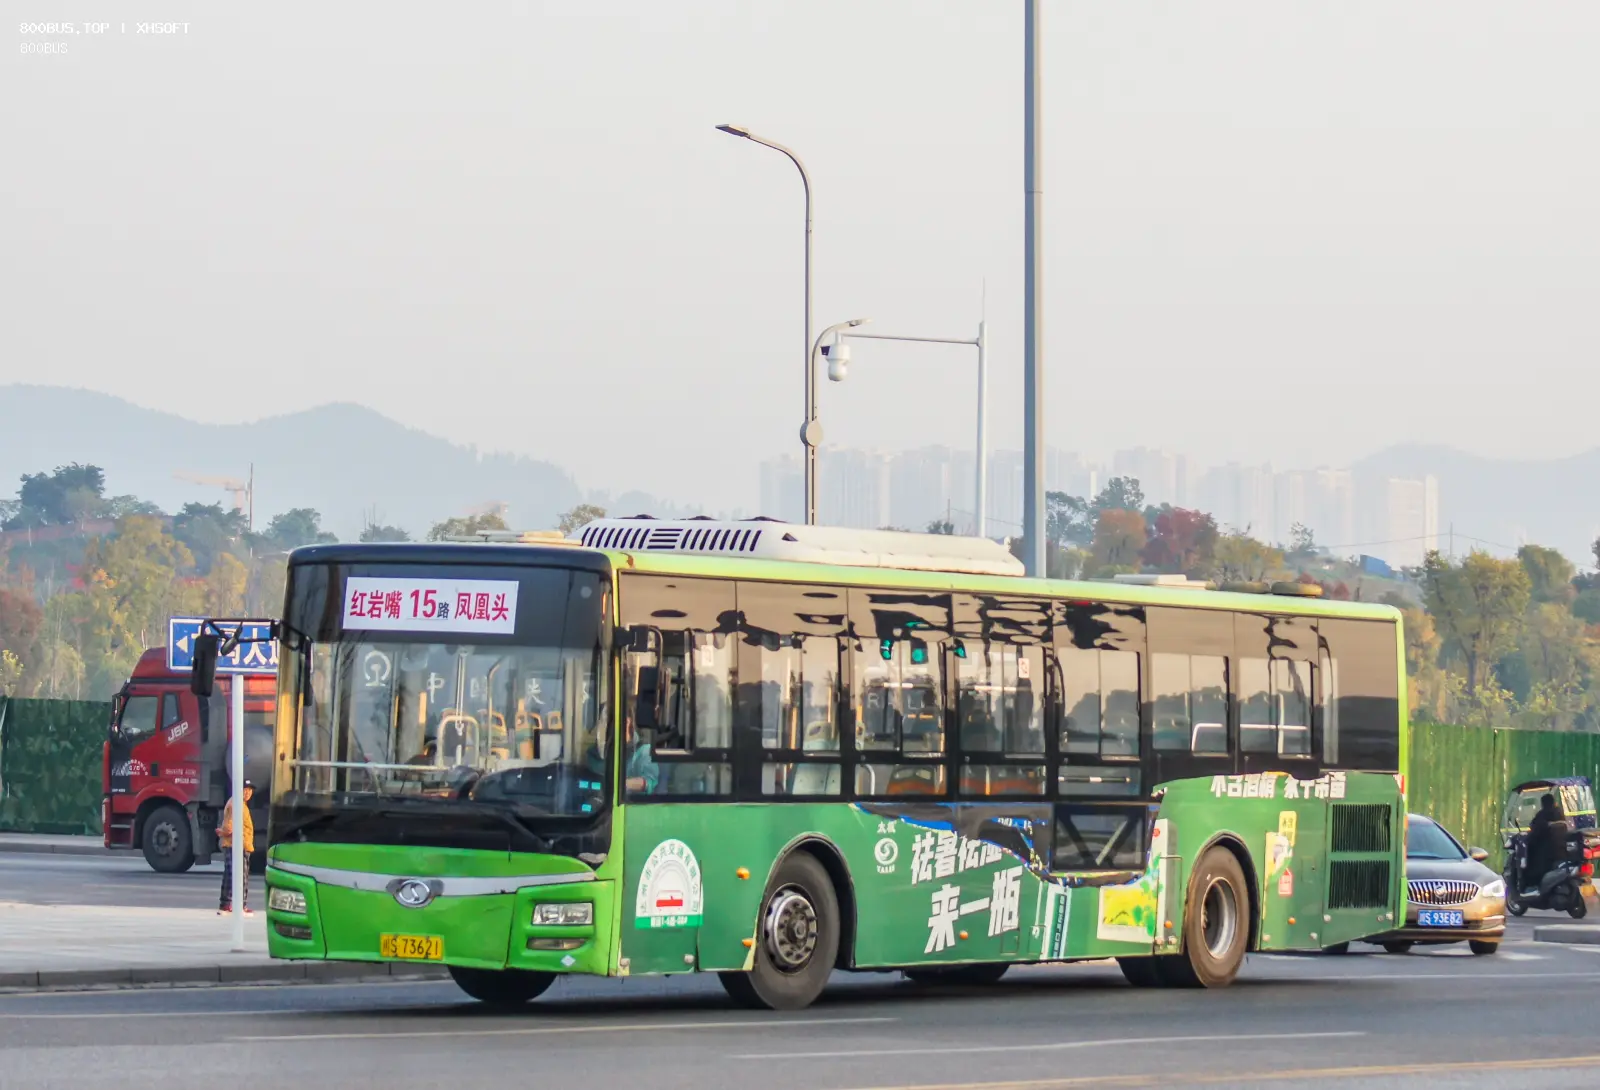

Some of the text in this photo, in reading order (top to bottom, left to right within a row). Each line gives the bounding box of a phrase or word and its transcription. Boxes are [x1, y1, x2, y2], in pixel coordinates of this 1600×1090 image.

[350, 590, 402, 619] 红岩嘴
[454, 592, 509, 621] 凤凰头
[924, 865, 1023, 954] 来一瓶
